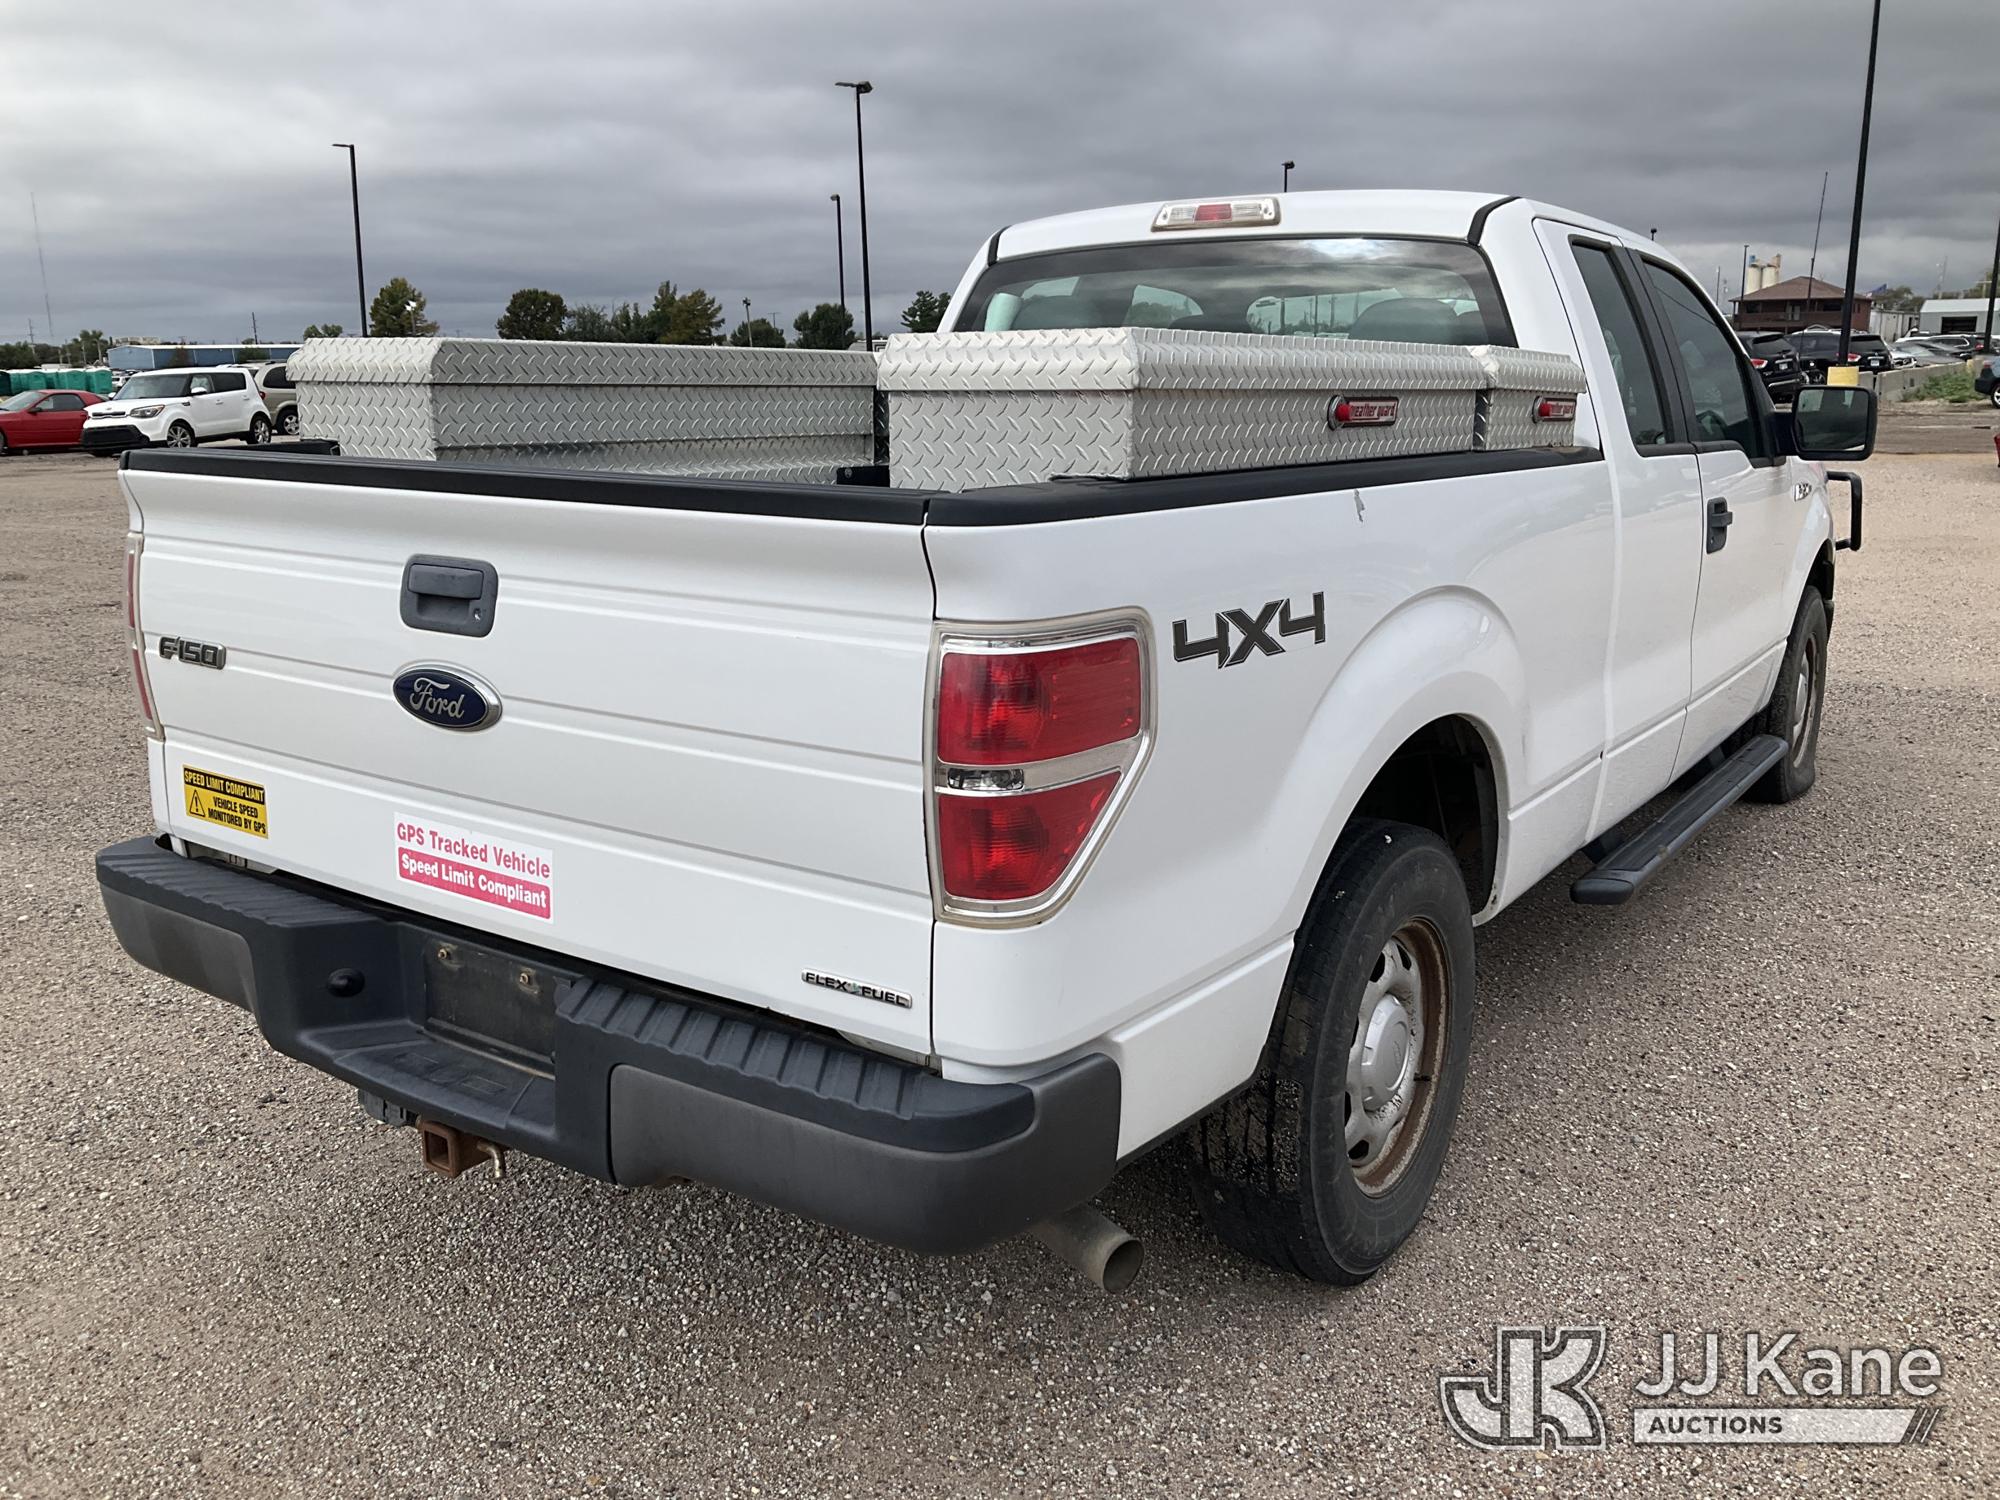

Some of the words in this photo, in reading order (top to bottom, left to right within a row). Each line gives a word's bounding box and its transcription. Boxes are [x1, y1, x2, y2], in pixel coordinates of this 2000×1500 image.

[409, 677, 465, 719] Ford
[184, 770, 205, 787] SPEED
[206, 776, 225, 792] LIMIT
[225, 781, 264, 803] COMPLIANT
[208, 808, 243, 828] MONITORED
[244, 818, 252, 830] BY
[253, 820, 266, 835] GPS
[213, 796, 238, 813] VEHICLE
[239, 803, 259, 818] SPEED
[397, 822, 424, 846] GPS
[429, 830, 488, 863] Tracked
[493, 846, 550, 879] Vehicle
[401, 852, 439, 878] Speed
[441, 863, 475, 888] Limit
[478, 874, 547, 908] Compliant
[805, 971, 848, 993] FLEX
[861, 985, 911, 1008] FUEL
